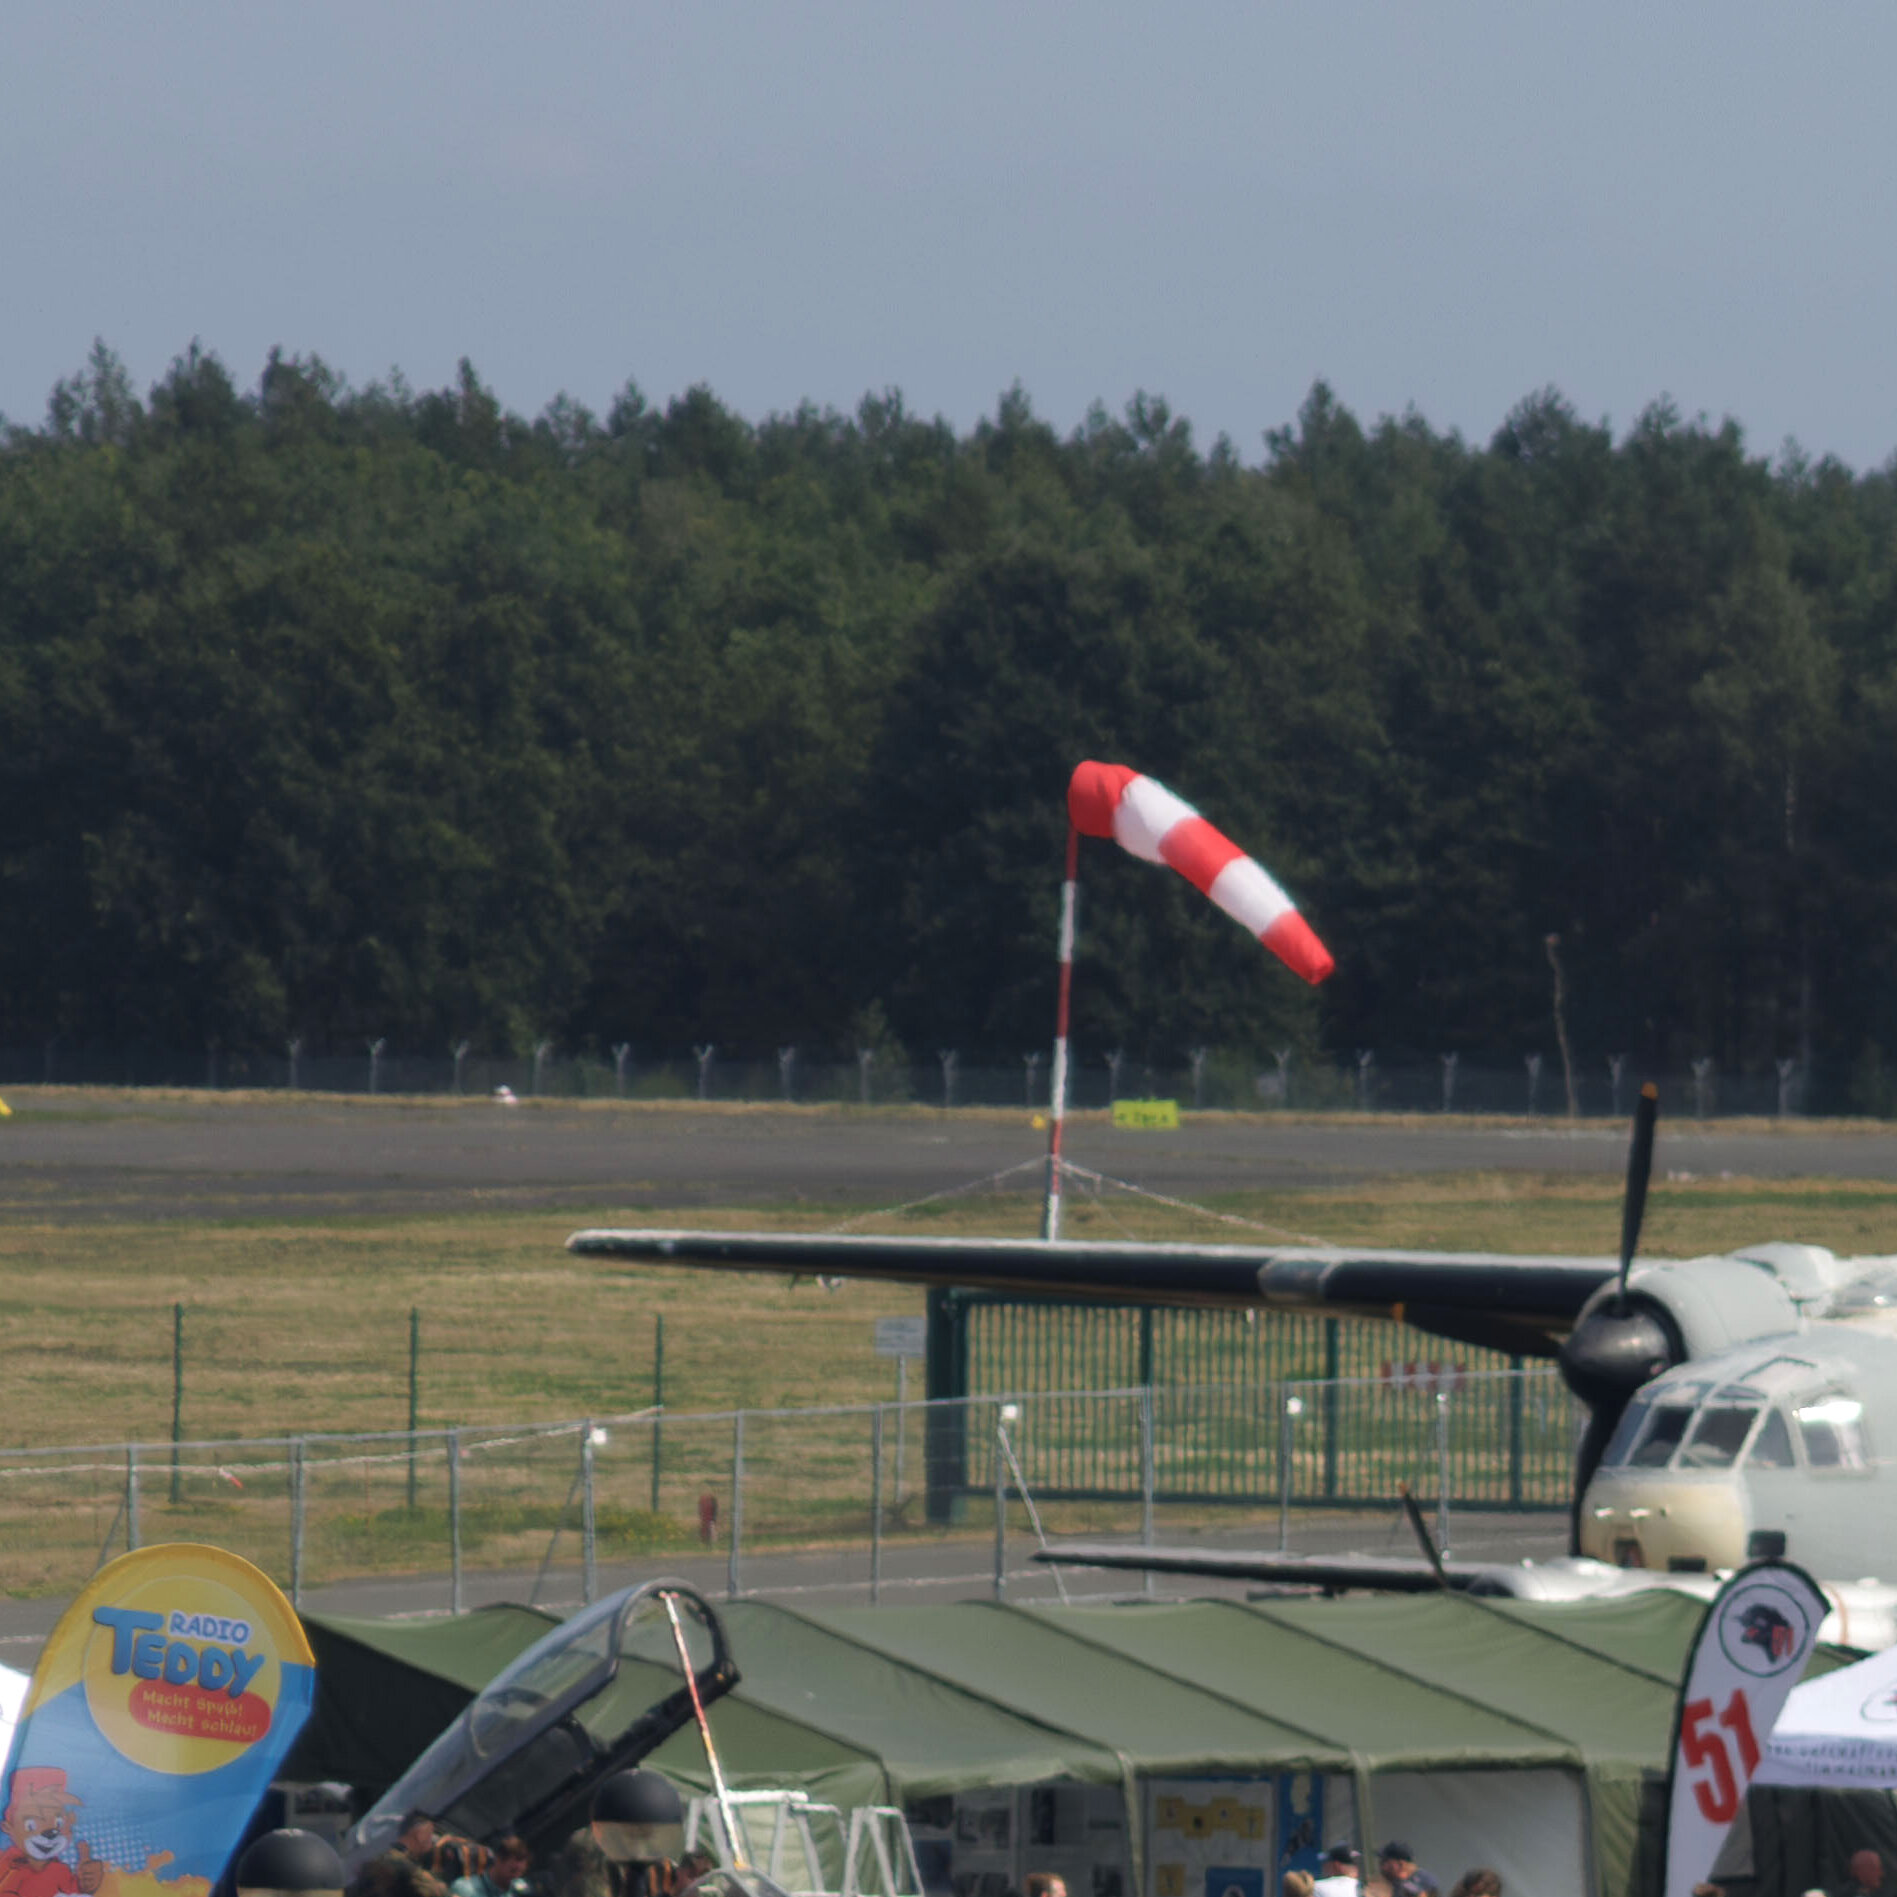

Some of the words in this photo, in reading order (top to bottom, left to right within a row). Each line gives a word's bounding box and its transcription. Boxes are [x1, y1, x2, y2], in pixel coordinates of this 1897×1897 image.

[170, 1611, 250, 1644] RADIO
[93, 1606, 266, 1698] TEDDY
[142, 1690, 189, 1709] Macht
[196, 1698, 243, 1718] Spaß!
[149, 1710, 195, 1729] Macht
[1681, 1688, 1762, 1825] 51
